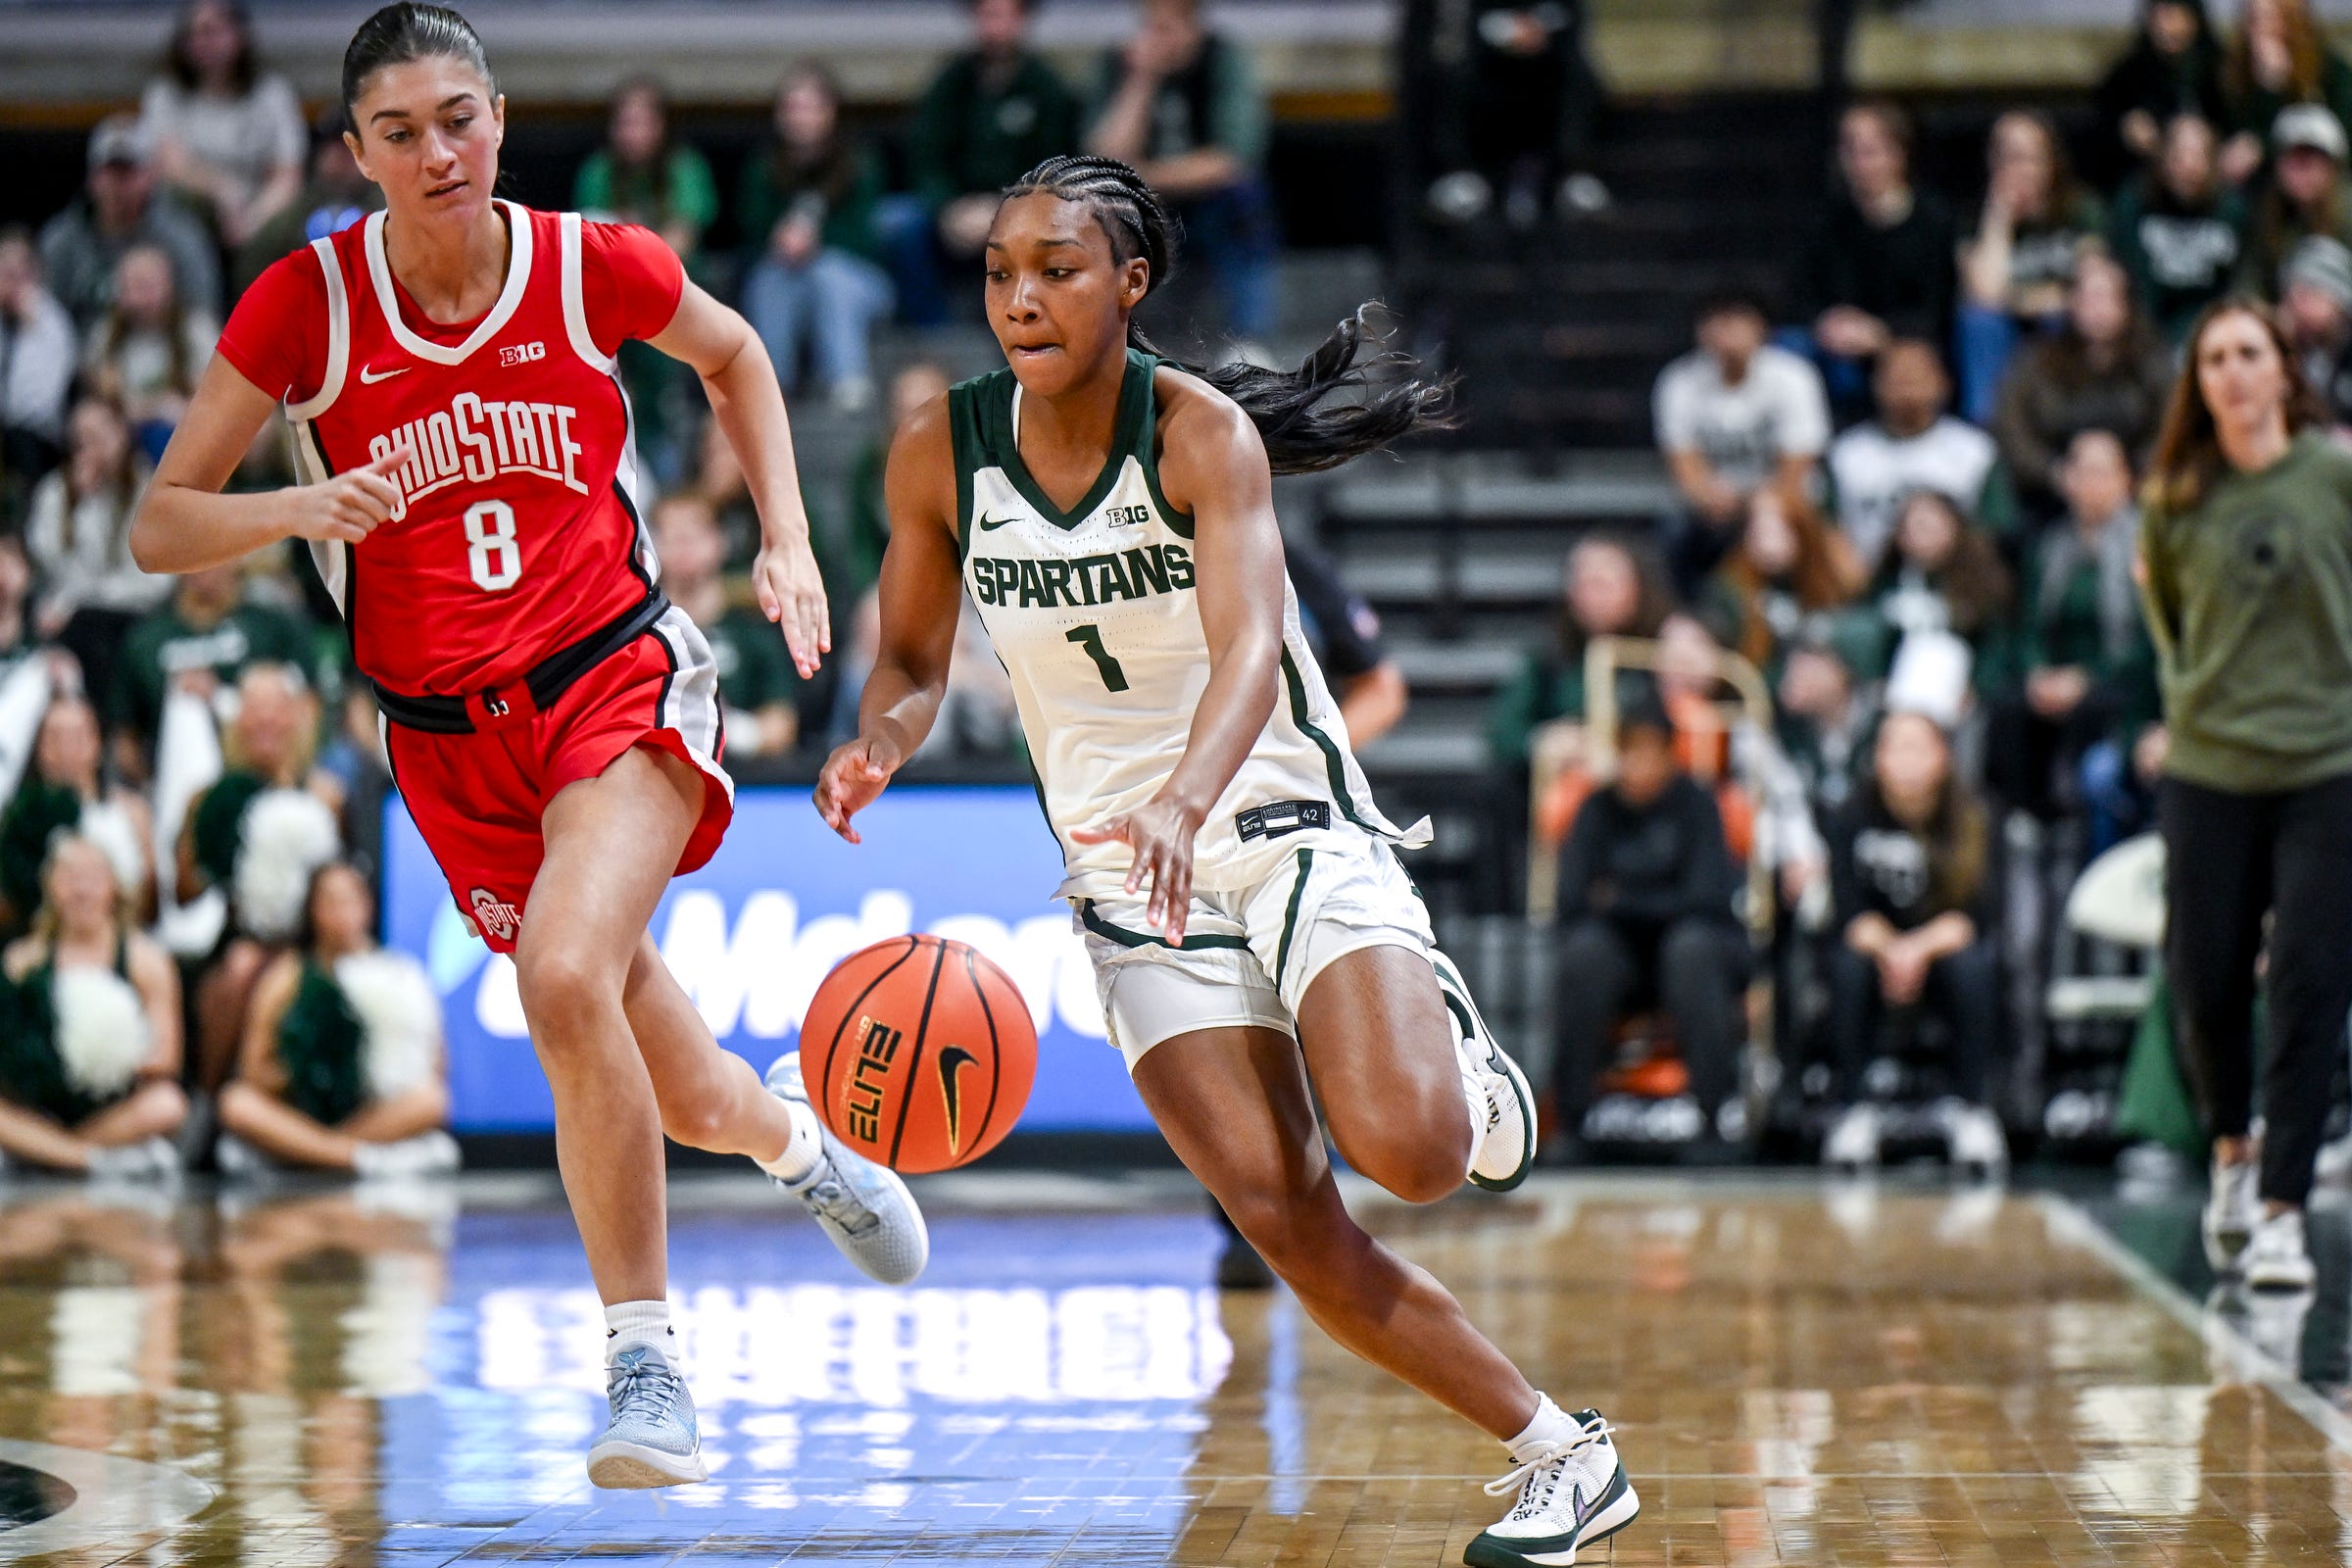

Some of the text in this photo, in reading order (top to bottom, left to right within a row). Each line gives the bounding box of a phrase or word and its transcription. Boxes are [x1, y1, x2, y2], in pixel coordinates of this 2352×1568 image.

[451, 391, 590, 497] STATE
[463, 498, 523, 592] 8
[972, 543, 1197, 609] SPARTANS
[1064, 623, 1130, 693] 1
[1302, 809, 1318, 821] 42
[848, 1021, 903, 1144] ELITE
